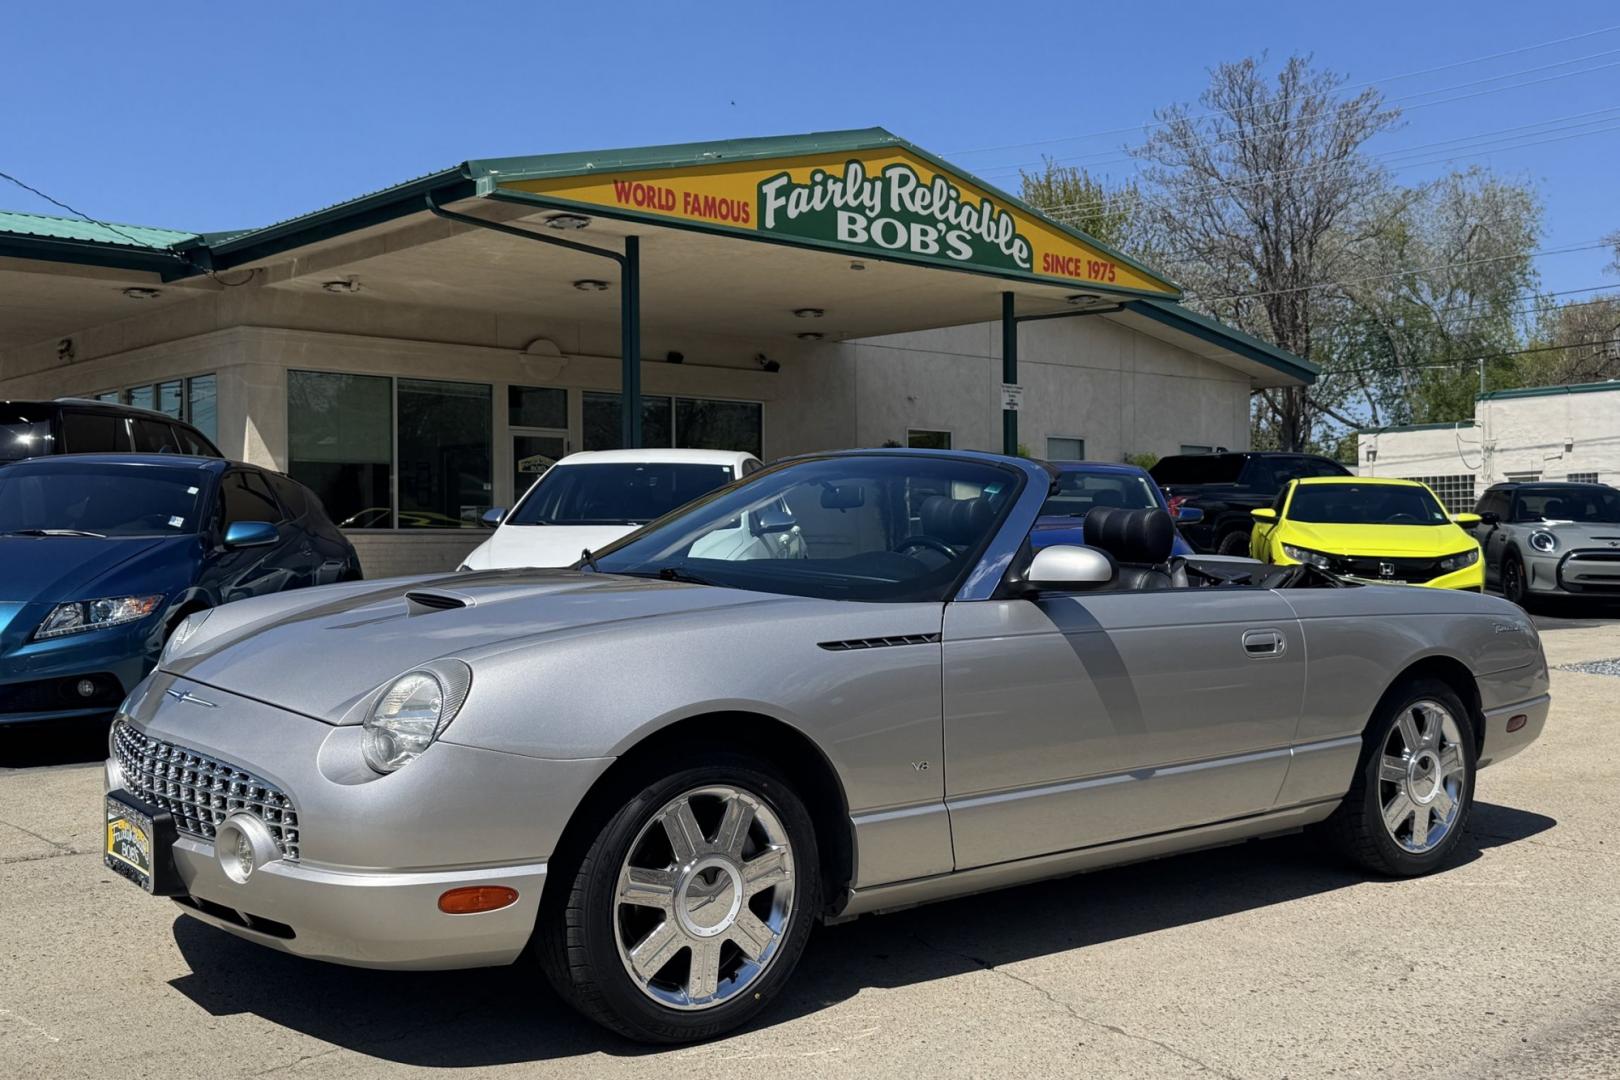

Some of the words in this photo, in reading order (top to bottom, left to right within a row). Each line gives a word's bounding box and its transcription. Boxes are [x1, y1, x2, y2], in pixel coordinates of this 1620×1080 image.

[614, 180, 676, 211] WORLD
[684, 192, 750, 224] FAMOUS
[762, 163, 882, 229] Fairly
[886, 167, 1030, 268] Reliable
[837, 210, 973, 260] BOB'S
[1043, 253, 1081, 277] SINCE
[1087, 260, 1116, 282] 1975
